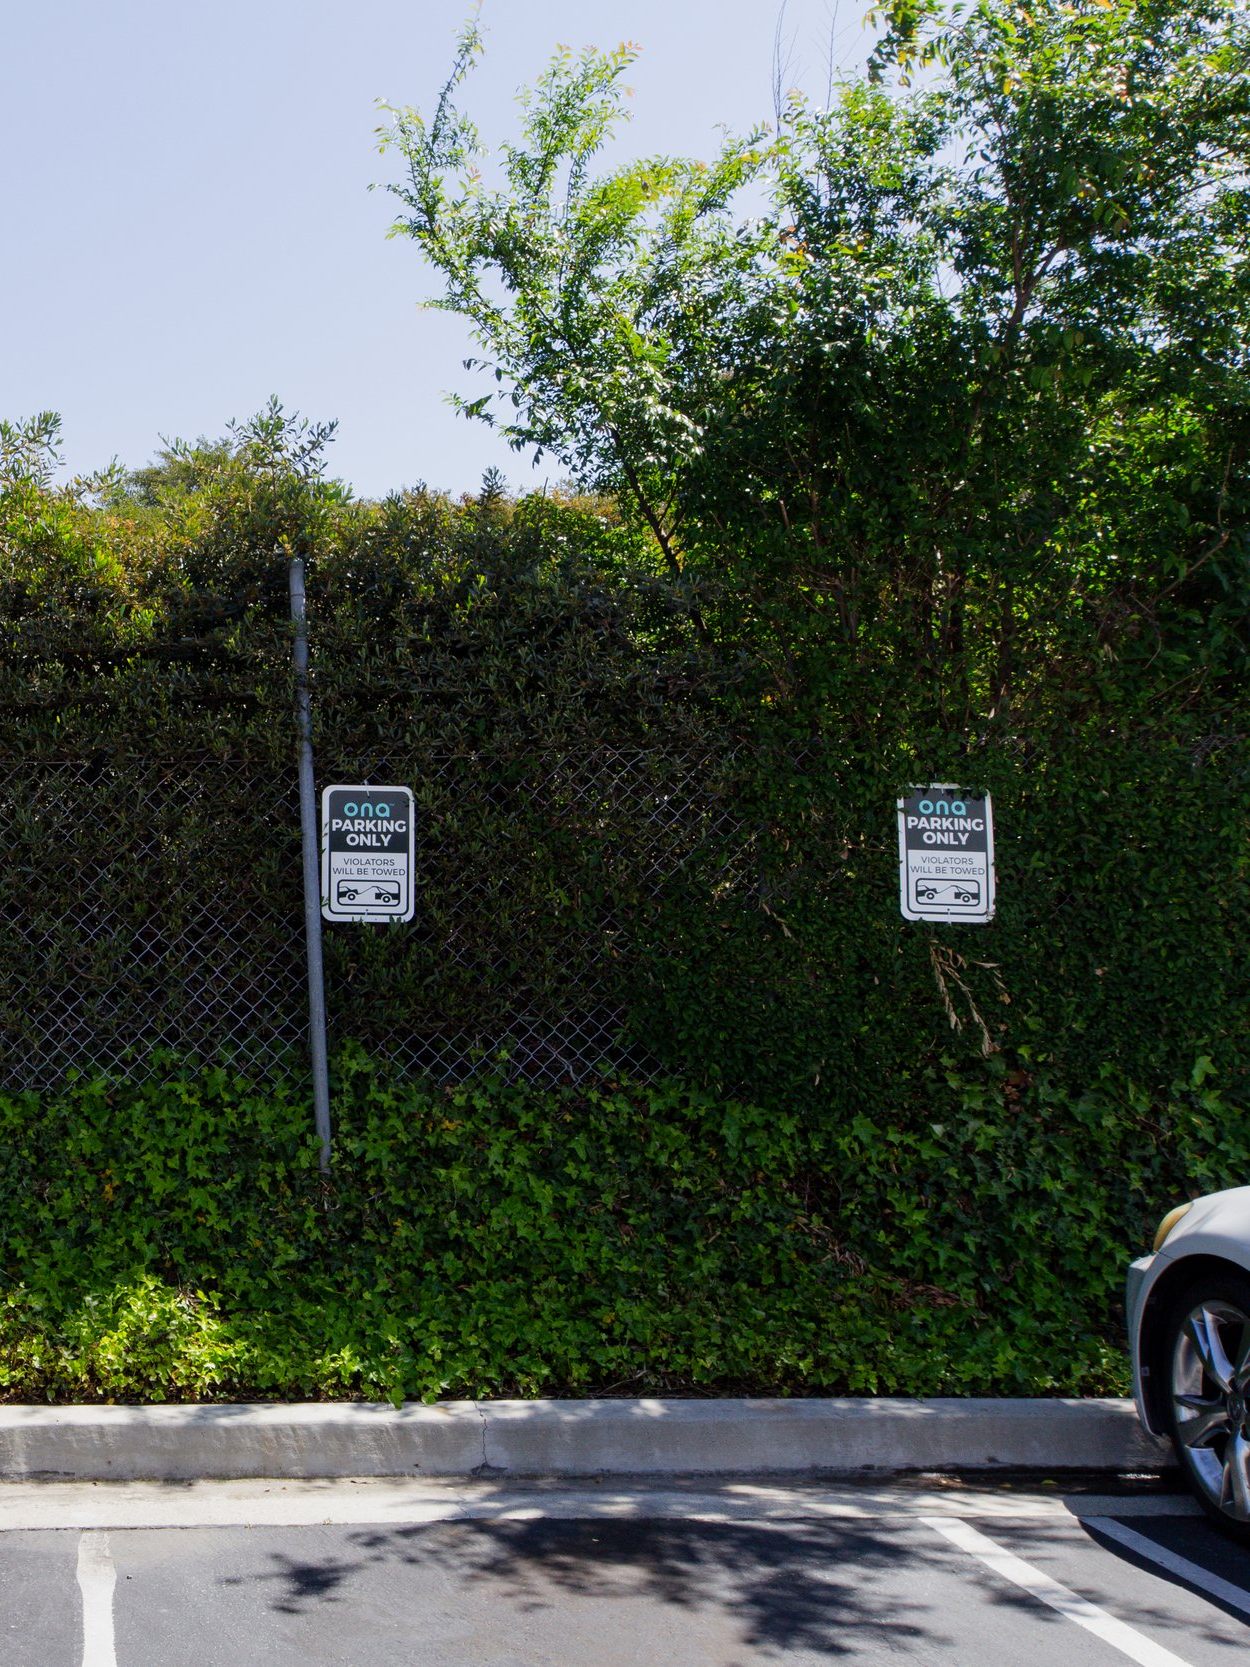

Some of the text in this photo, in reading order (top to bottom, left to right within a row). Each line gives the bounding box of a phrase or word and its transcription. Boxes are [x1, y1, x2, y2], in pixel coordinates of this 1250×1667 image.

[332, 819, 406, 833] PARKING
[907, 817, 984, 831] PARKING
[346, 834, 392, 847] ONLY
[923, 831, 969, 845] ONLY
[344, 858, 395, 866] VIOLATORS
[921, 856, 974, 865] VIOLATORS
[333, 867, 354, 875] WILL
[372, 868, 406, 876] TOWED
[910, 866, 932, 874] WILL
[950, 867, 985, 875] TOWED
